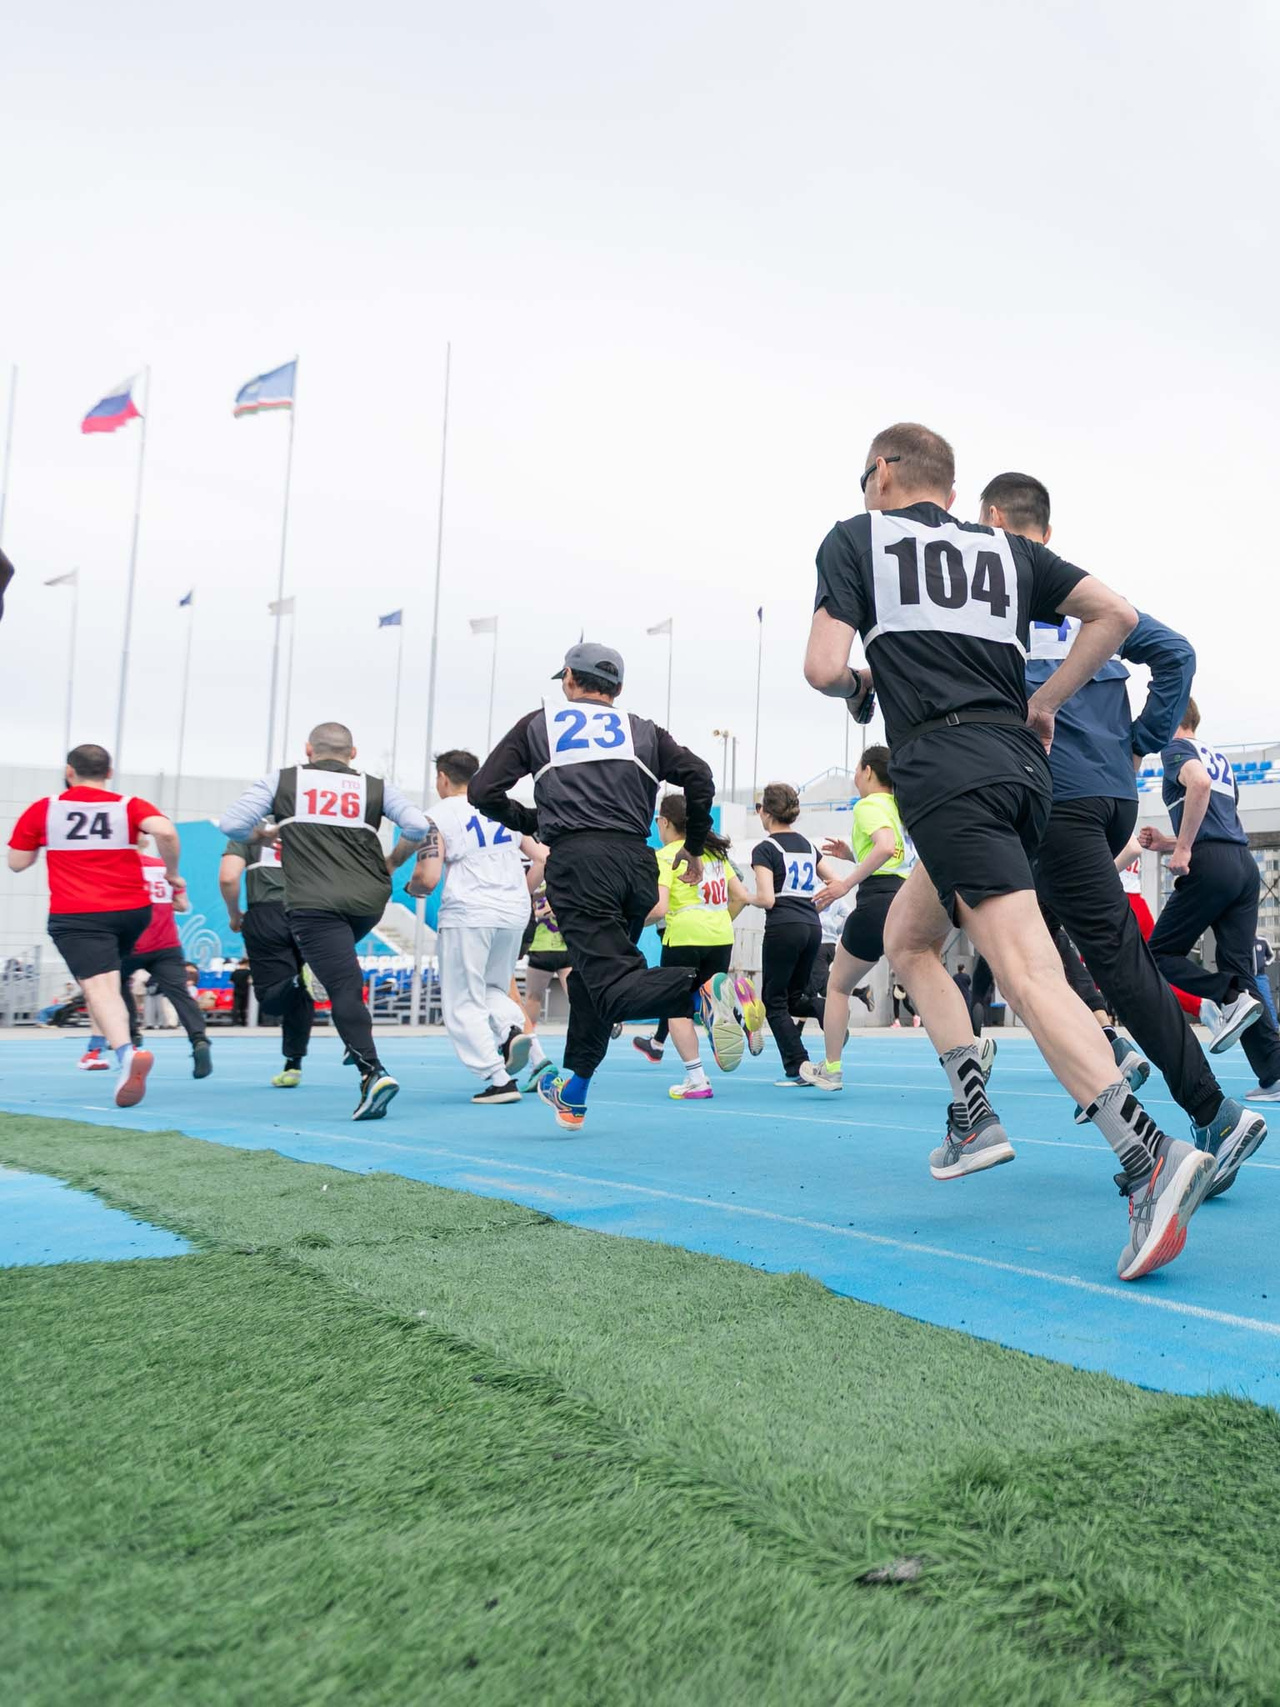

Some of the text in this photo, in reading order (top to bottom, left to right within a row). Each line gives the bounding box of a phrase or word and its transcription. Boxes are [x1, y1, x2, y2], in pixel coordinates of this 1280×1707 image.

[884, 536, 1010, 619] 104
[553, 709, 626, 753] 23
[1200, 747, 1232, 787] 32
[303, 788, 361, 819] 126
[66, 812, 114, 841] 24
[150, 881, 167, 899] 5
[788, 860, 815, 891] 12
[702, 878, 728, 905] 102
